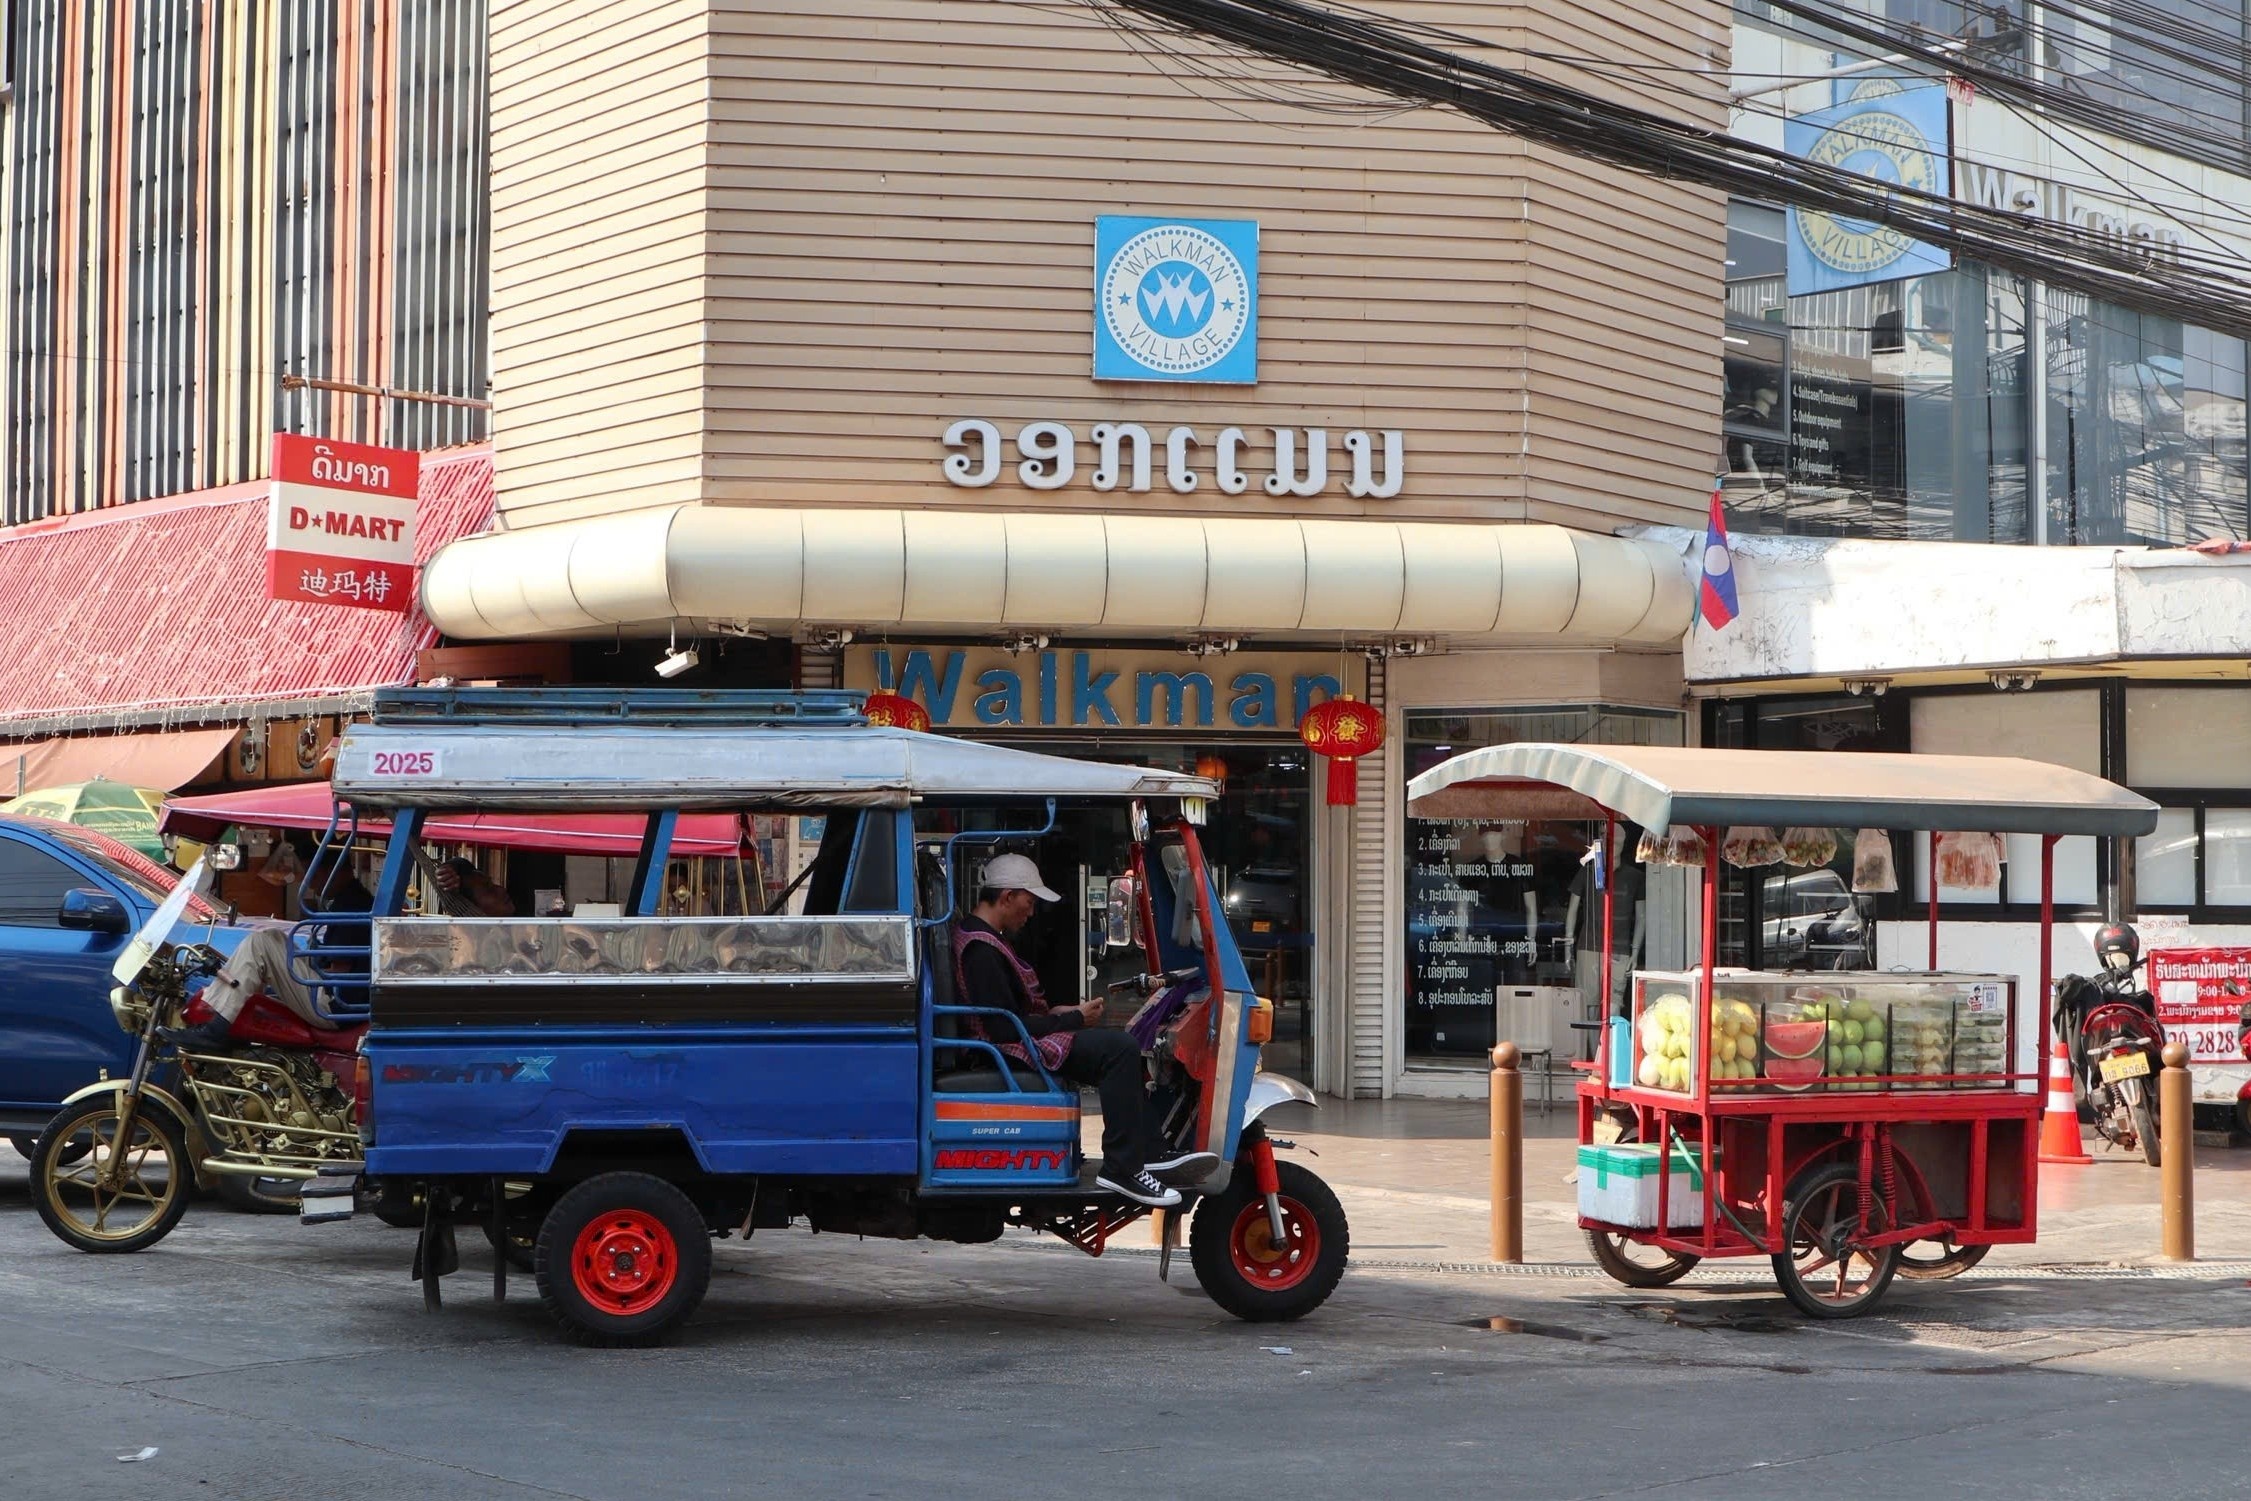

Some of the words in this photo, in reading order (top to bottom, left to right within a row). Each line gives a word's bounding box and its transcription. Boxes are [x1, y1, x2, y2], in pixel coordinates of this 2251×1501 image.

[1821, 225, 1901, 260] VILLAG
[1123, 239, 1229, 284] WALKMAN
[1128, 322, 1223, 361] VILLAGE
[942, 419, 1405, 498] ວອກແມນ
[299, 567, 392, 603] 迪玛特
[872, 649, 1342, 727] Walkman
[374, 751, 434, 776] 2025
[1418, 838, 1427, 851] 2.
[1418, 862, 1427, 876] 3.
[1418, 888, 1427, 901] 4.
[1418, 914, 1427, 926] 5.
[1418, 939, 1427, 952] 6.
[1417, 965, 1426, 979] 7.
[1418, 991, 1427, 1005] 8.
[2195, 1030, 2236, 1053] 2828
[972, 1127, 1000, 1135] SUPER
[1004, 1127, 1021, 1135] CAB
[934, 1149, 1068, 1170] MIGHTY
